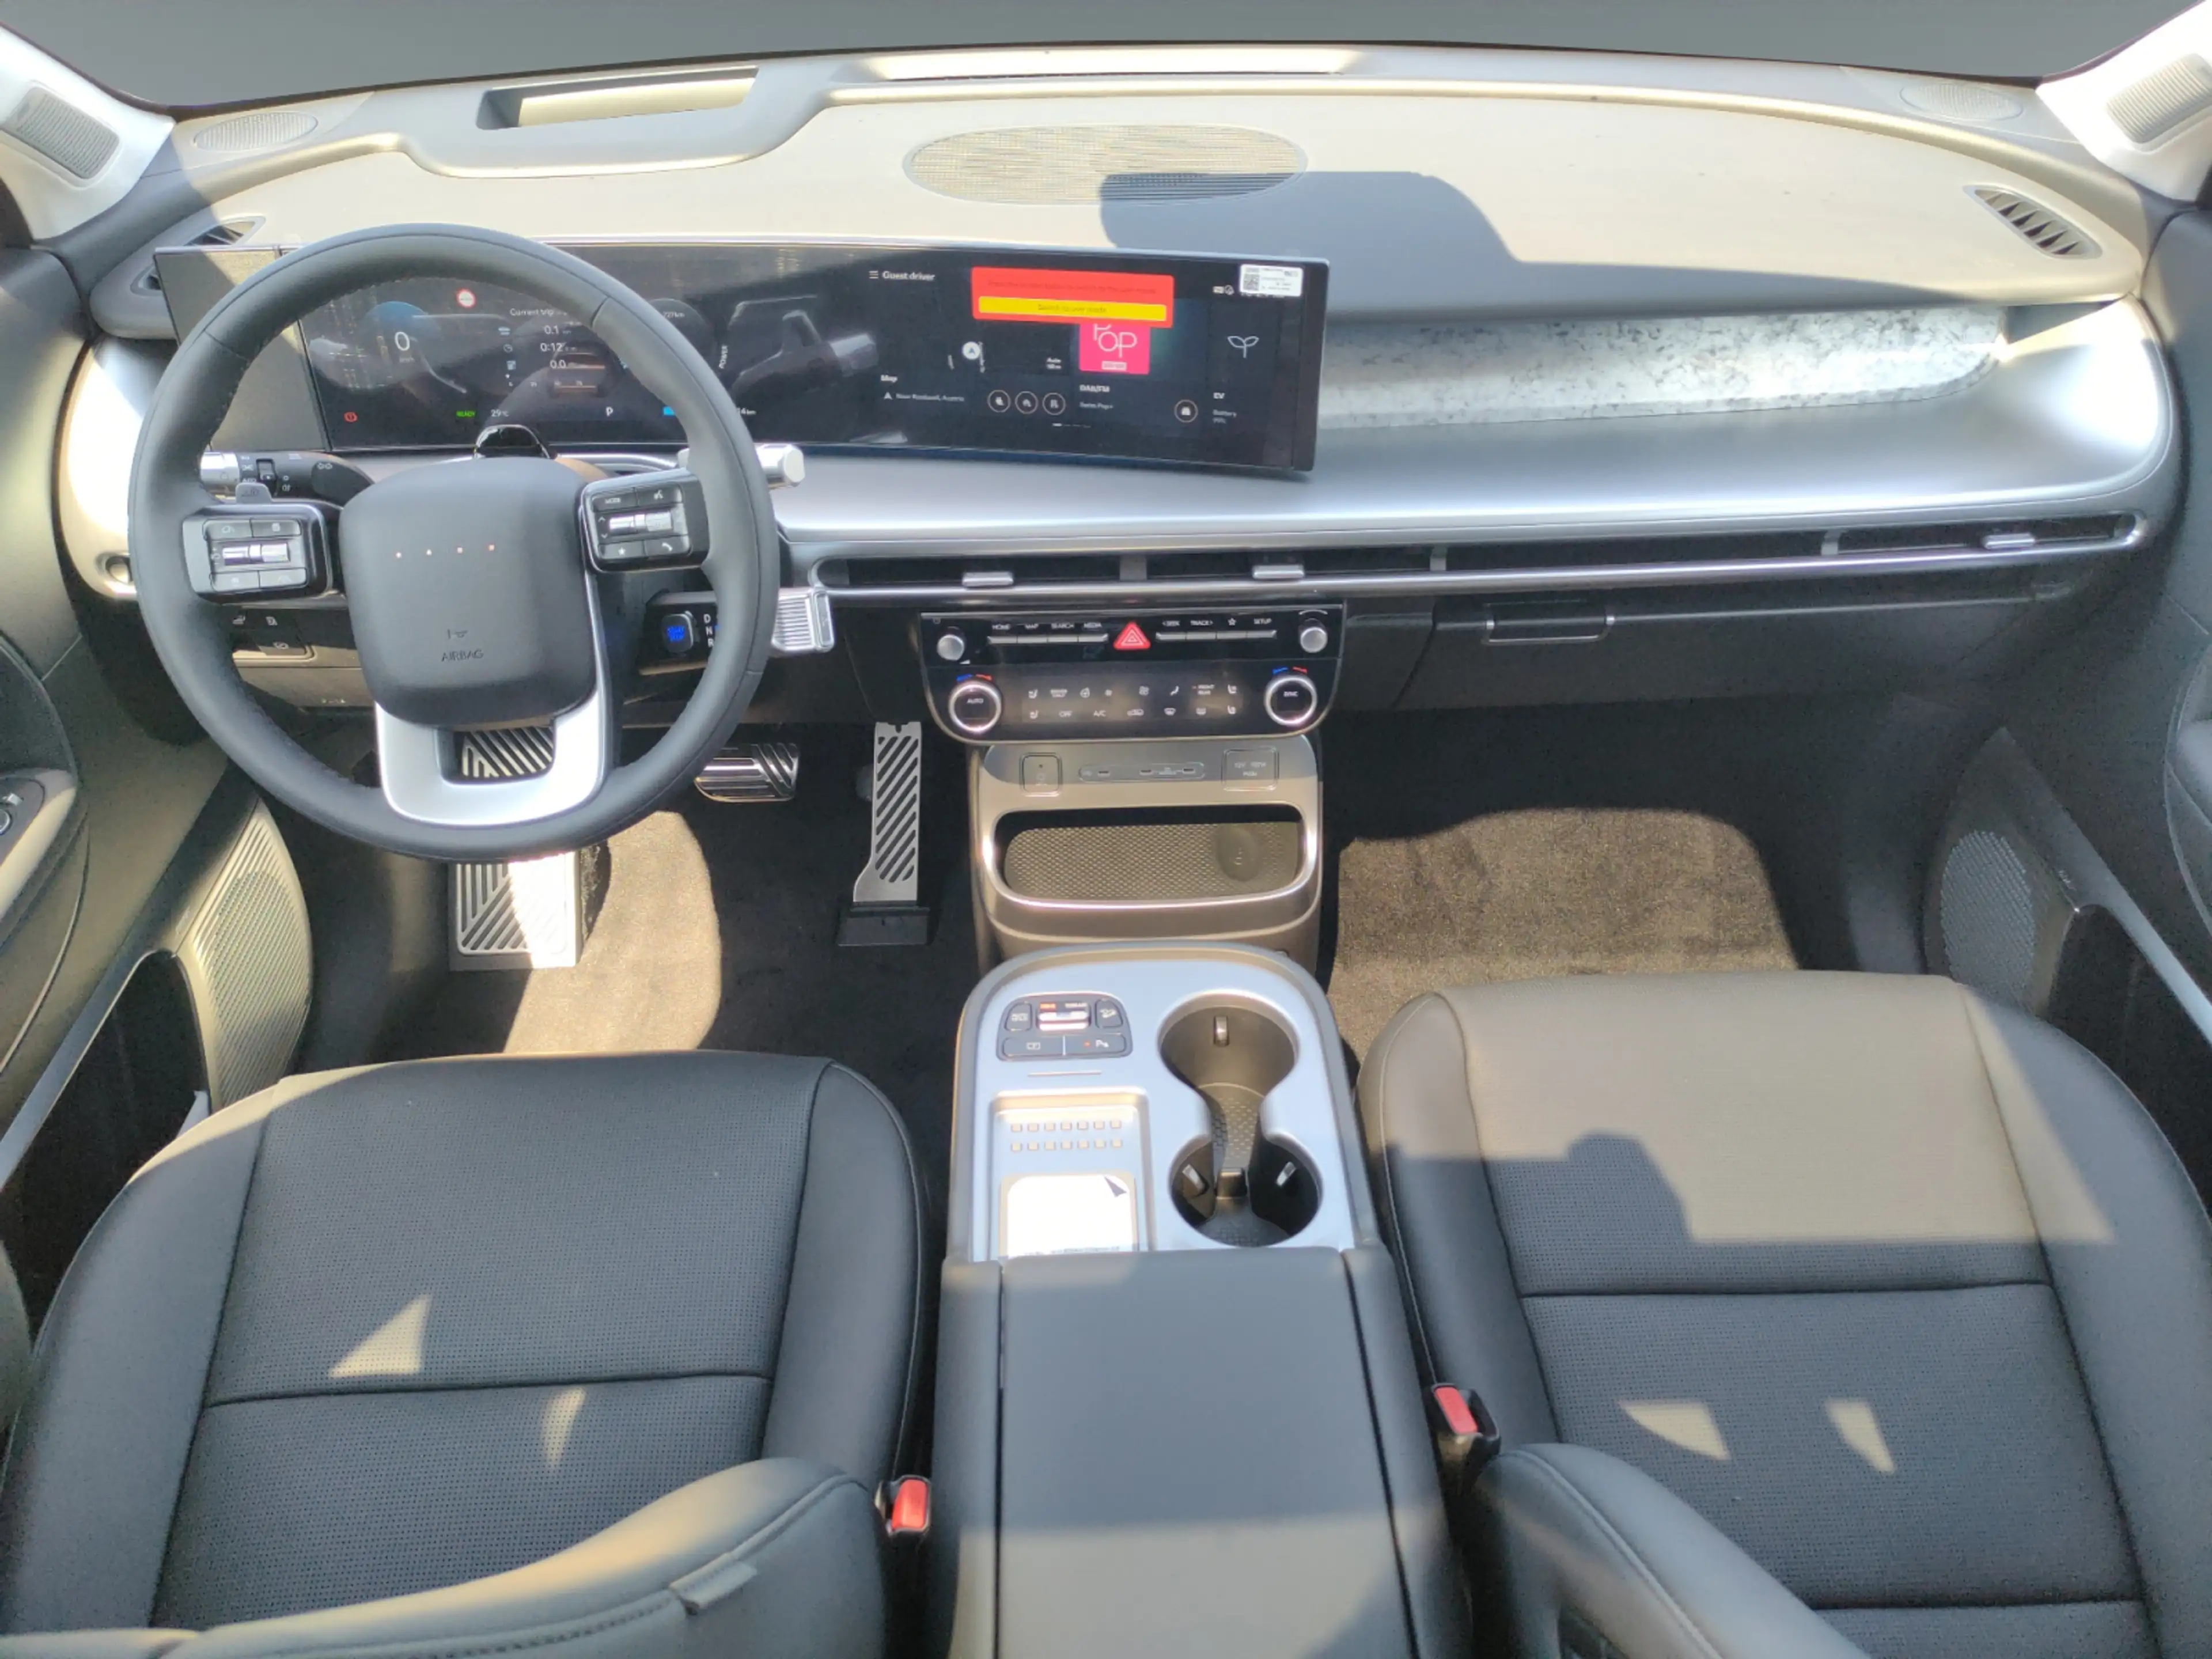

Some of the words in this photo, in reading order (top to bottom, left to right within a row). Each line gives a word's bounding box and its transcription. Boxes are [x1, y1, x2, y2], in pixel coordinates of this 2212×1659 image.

[882, 270, 907, 280] Guest
[909, 271, 935, 282] driver
[510, 308, 539, 316] Current
[543, 325, 559, 334] 0.1
[394, 331, 410, 351] 0
[540, 342, 563, 353] 0:12
[549, 359, 566, 369] 0.0
[605, 406, 613, 417] P
[703, 613, 711, 624] D
[706, 626, 713, 635] N
[441, 649, 484, 662] AIRBAG
